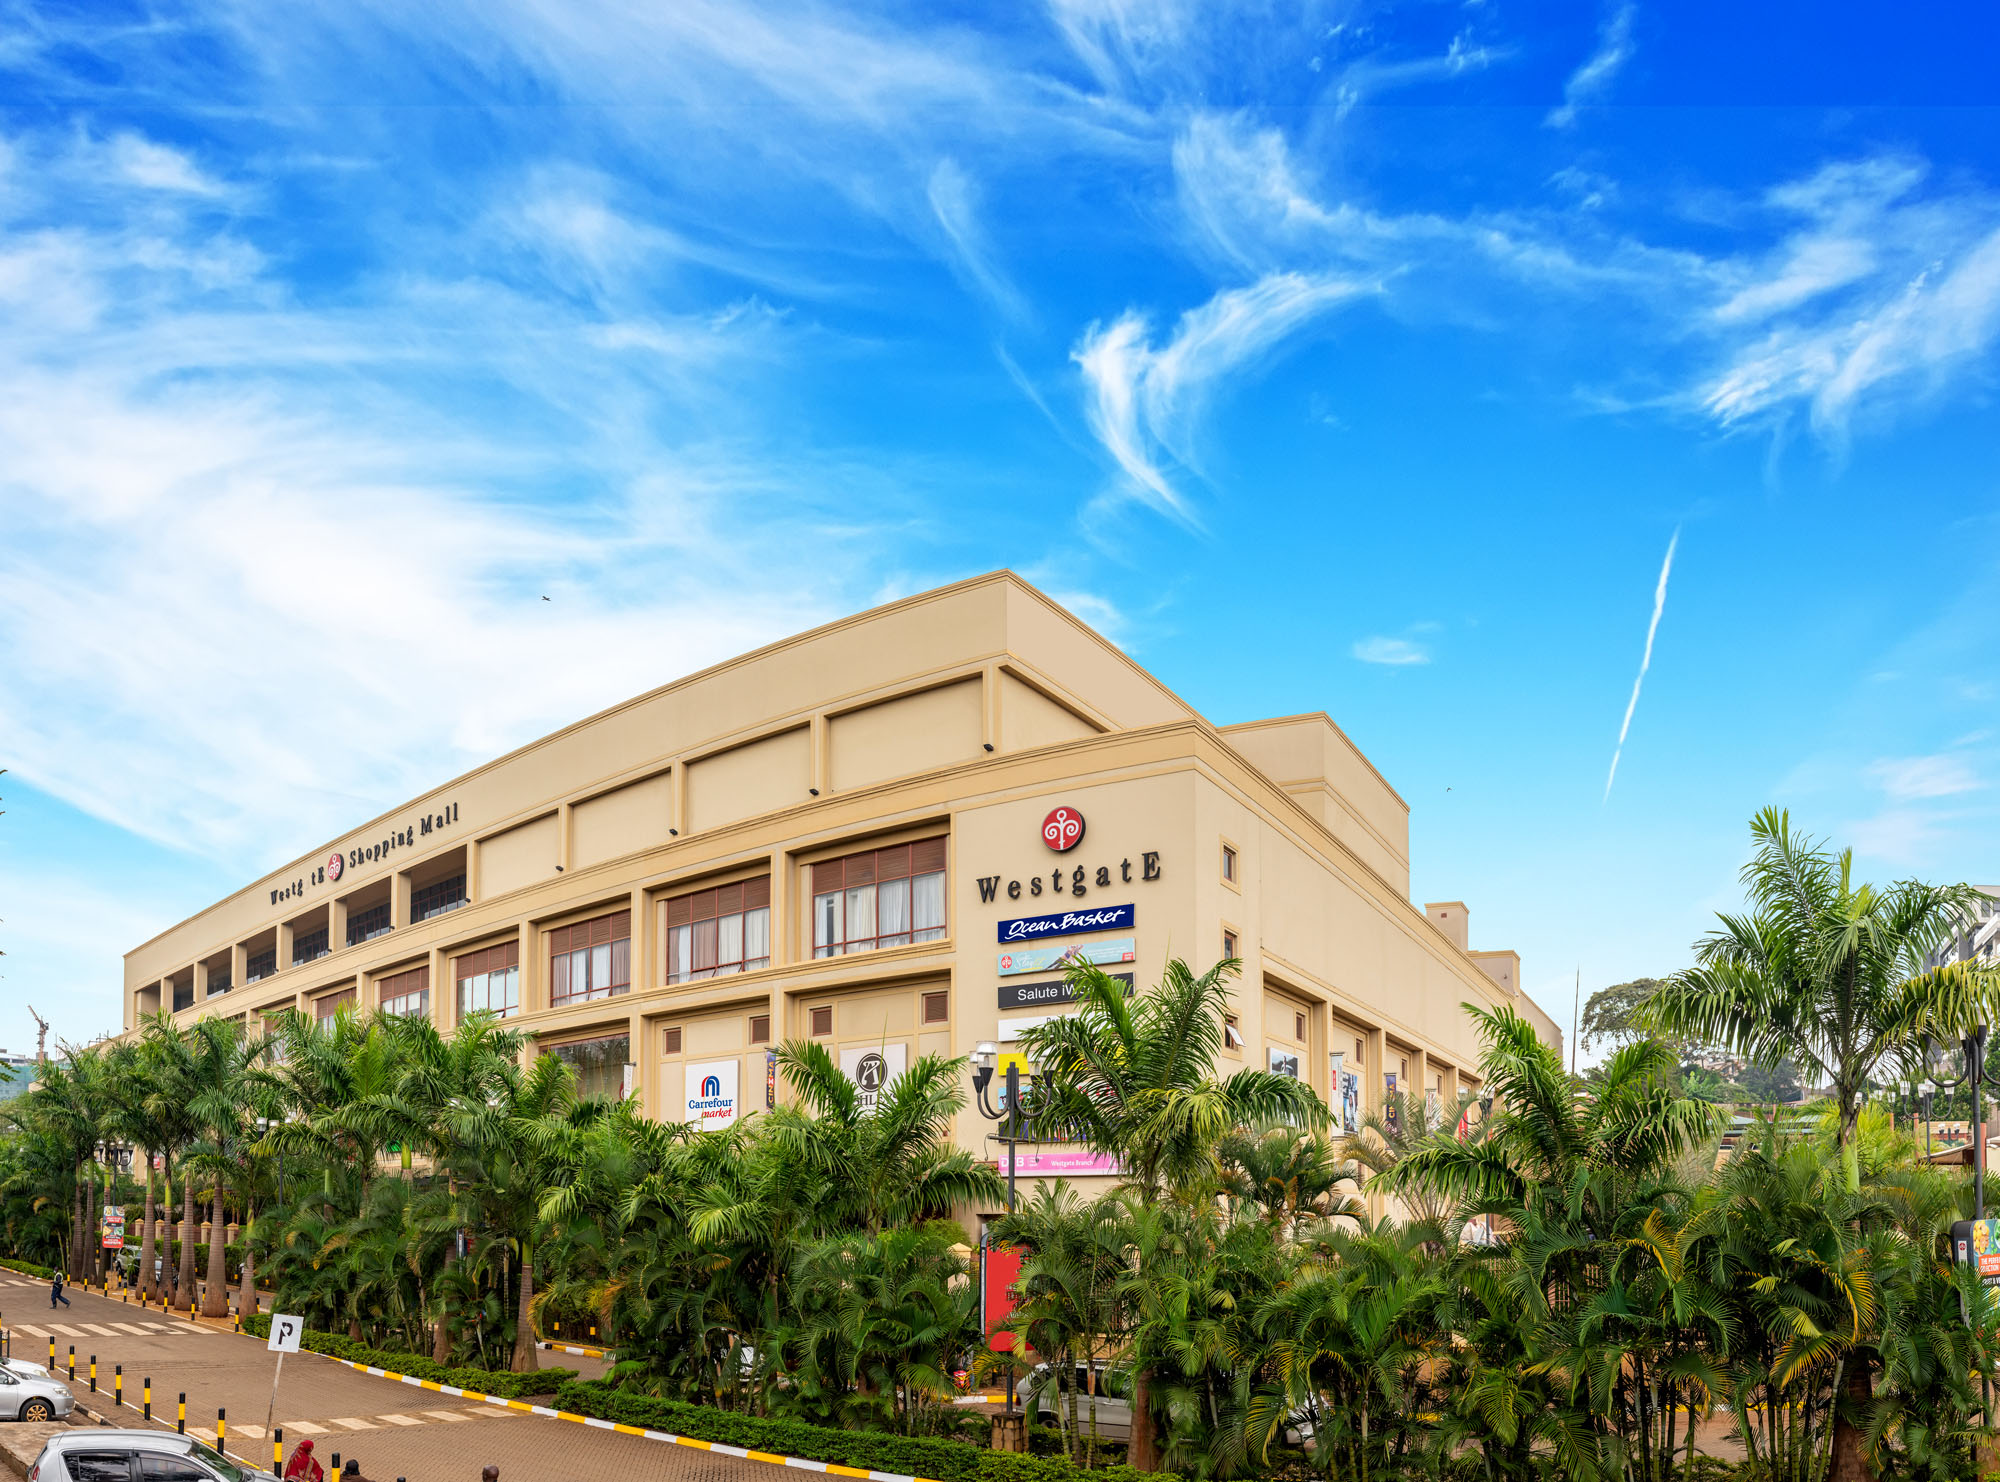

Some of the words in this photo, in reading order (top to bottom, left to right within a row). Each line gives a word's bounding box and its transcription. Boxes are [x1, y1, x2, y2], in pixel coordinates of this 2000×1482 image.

[270, 866, 324, 905] WestgtE
[349, 825, 414, 868] Shopping
[420, 802, 459, 836] Mall
[976, 851, 1161, 904] WestgatE
[1004, 919, 1060, 940] Ocean
[1058, 909, 1126, 931] Basket
[1017, 987, 1058, 1001] Salute
[688, 1097, 733, 1110] Carrefour
[701, 1107, 733, 1119] market
[1001, 1156, 1024, 1168] DB
[1051, 1160, 1075, 1168] Westgate
[1075, 1159, 1094, 1167] Branch
[278, 1322, 294, 1345] P
